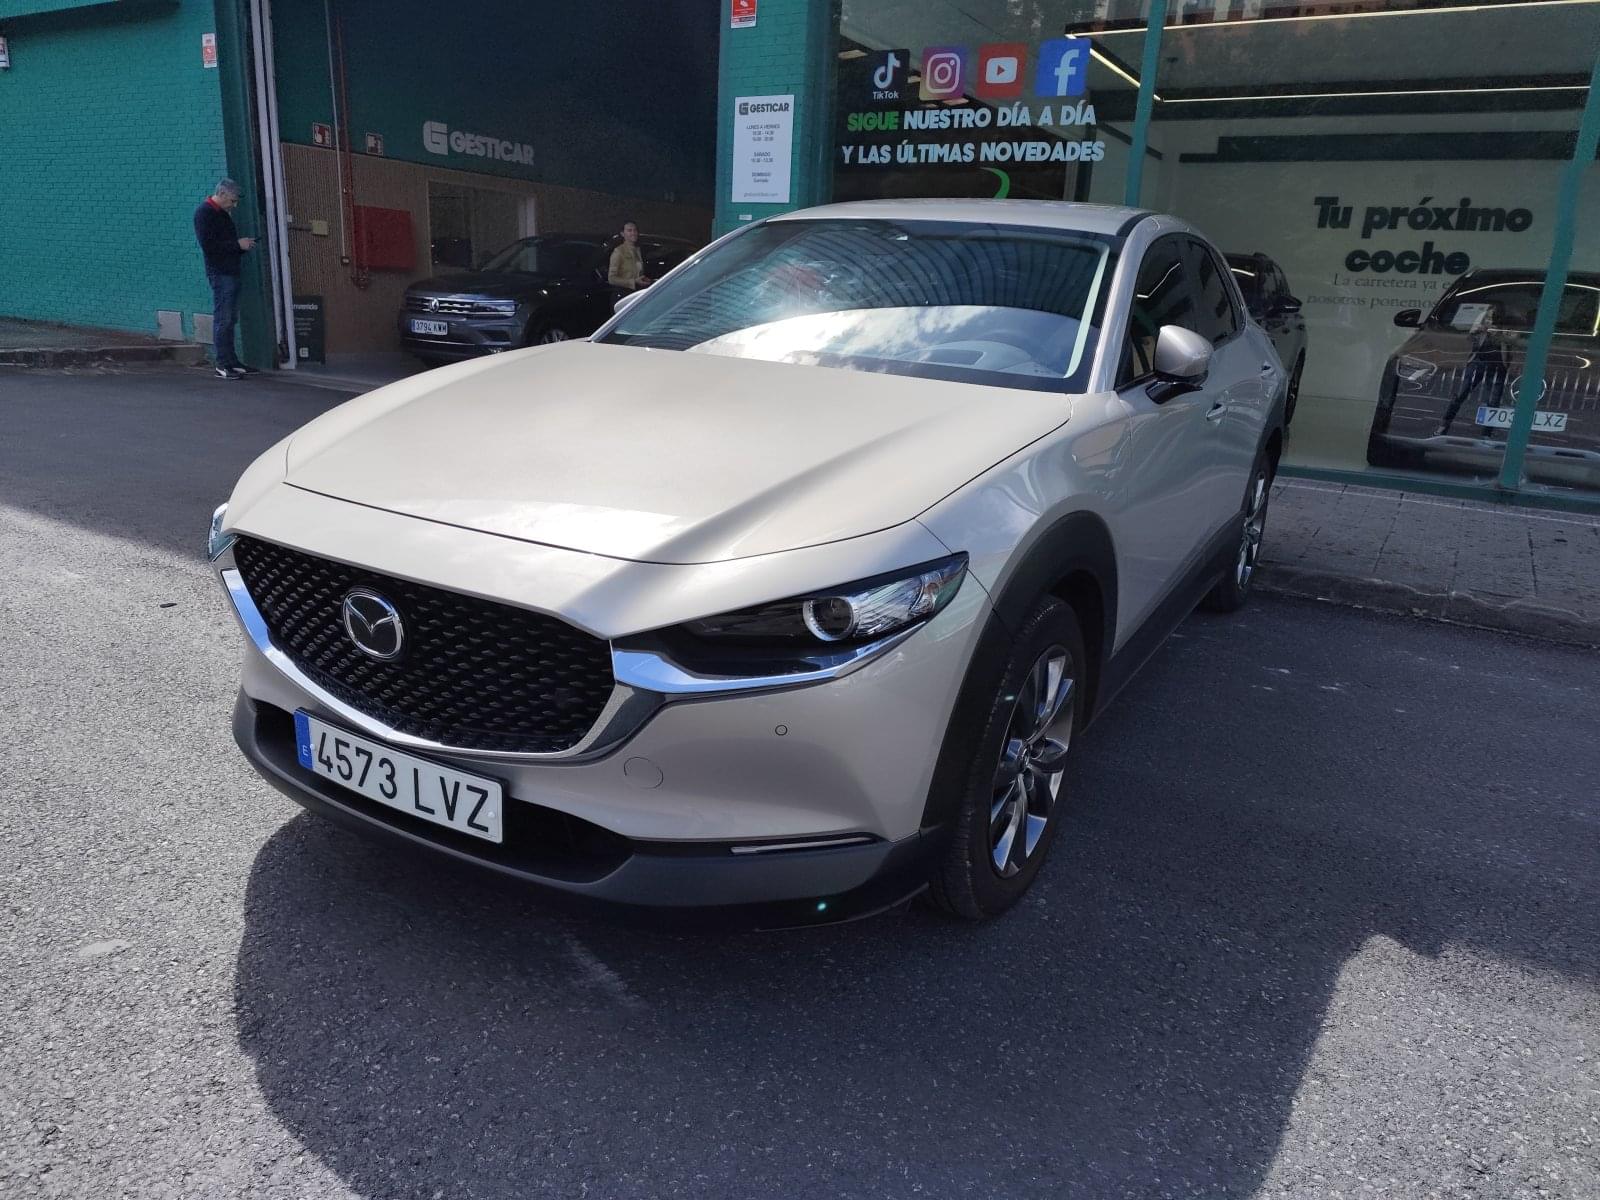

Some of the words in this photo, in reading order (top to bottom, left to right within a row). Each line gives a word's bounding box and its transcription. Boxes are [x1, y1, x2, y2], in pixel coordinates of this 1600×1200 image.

[750, 103, 790, 113] GESTICAR
[873, 91, 900, 100] TikTok
[847, 111, 900, 131] SIGUE
[903, 107, 992, 130] NUESTRO
[997, 101, 1031, 127] DÍA
[1037, 105, 1054, 126] A
[1060, 100, 1097, 126] DÍA
[449, 130, 535, 166] GESTICAR
[842, 146, 855, 164] Y
[858, 145, 893, 164] LAS
[896, 140, 975, 163] ÚLTIMAS
[980, 140, 1106, 162] NOVEDADES
[1314, 196, 1353, 229] Tu
[1361, 196, 1533, 239] próximo
[1345, 241, 1470, 275] coche
[1333, 273, 1350, 286] La
[1354, 277, 1417, 289] carretera
[1423, 280, 1437, 291] ya
[1533, 413, 1565, 428] LXZ
[317, 732, 398, 800] 4573
[413, 768, 489, 833] LVZ
